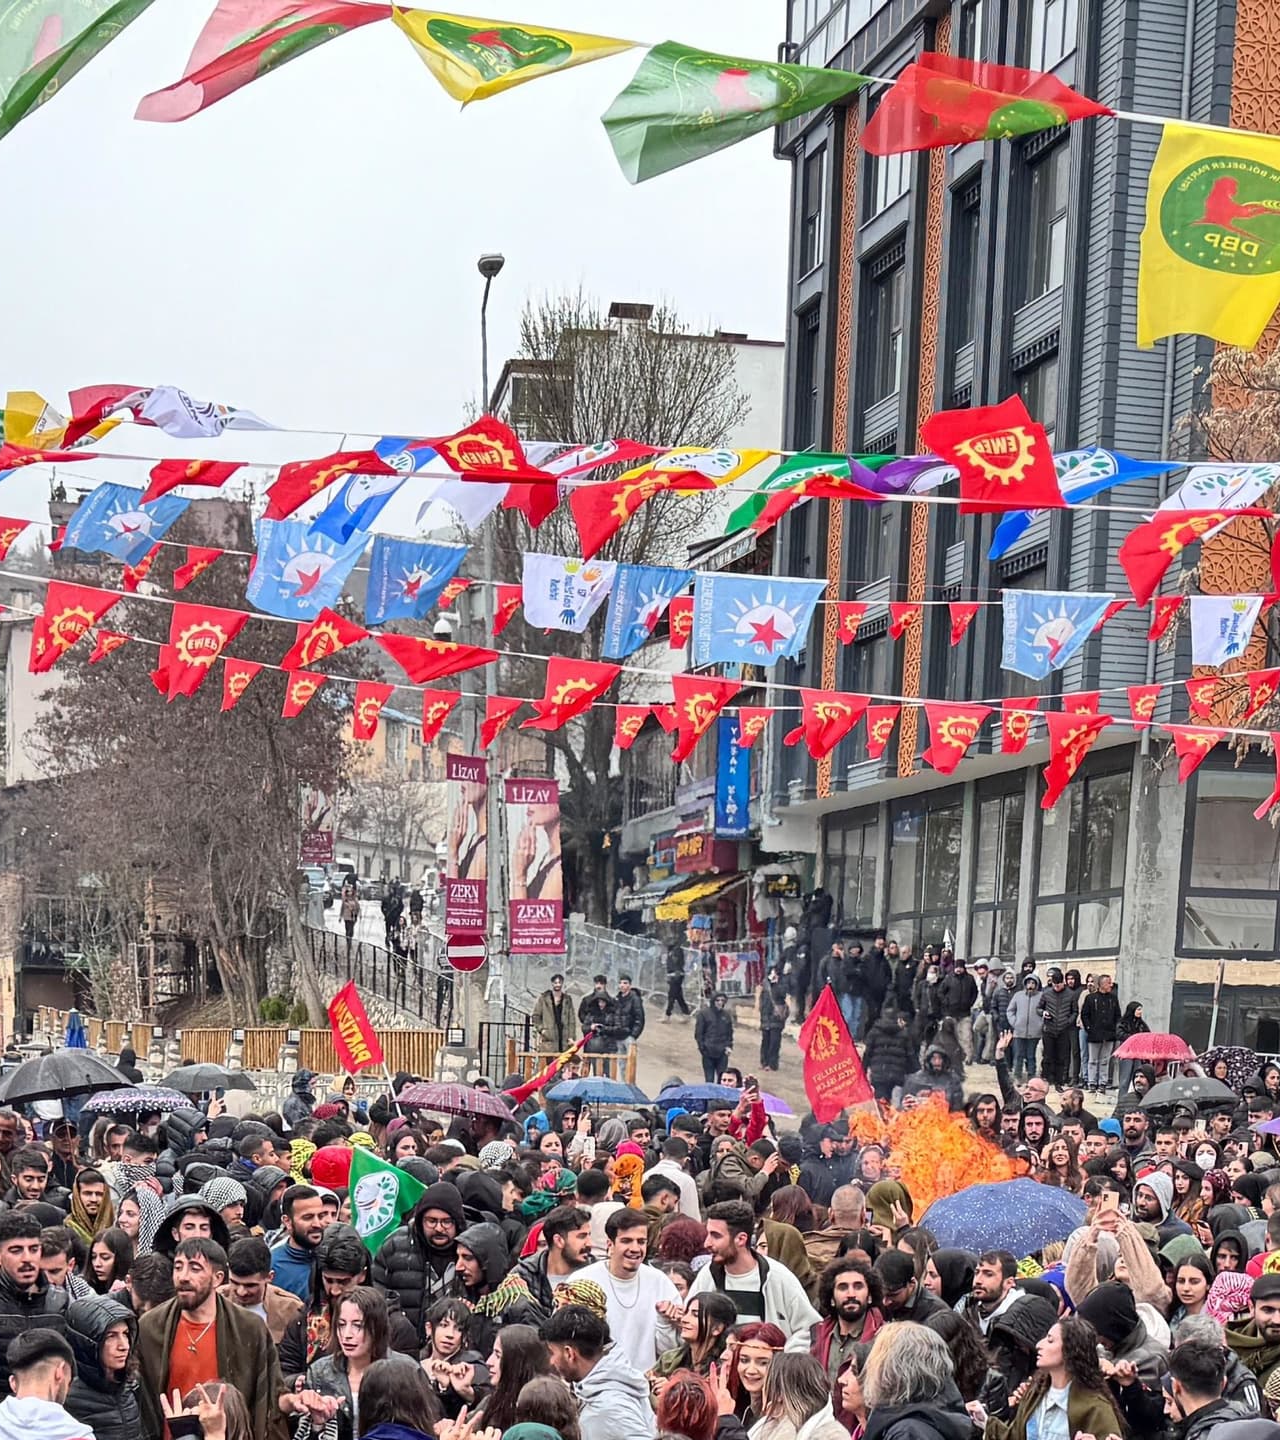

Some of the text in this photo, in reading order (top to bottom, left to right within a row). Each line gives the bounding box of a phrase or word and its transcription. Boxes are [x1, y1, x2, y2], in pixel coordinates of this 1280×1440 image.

[452, 763, 480, 781] LİZAY
[512, 786, 551, 803] LİZAY
[451, 884, 479, 898] ZERN
[517, 904, 555, 919] ZERN
